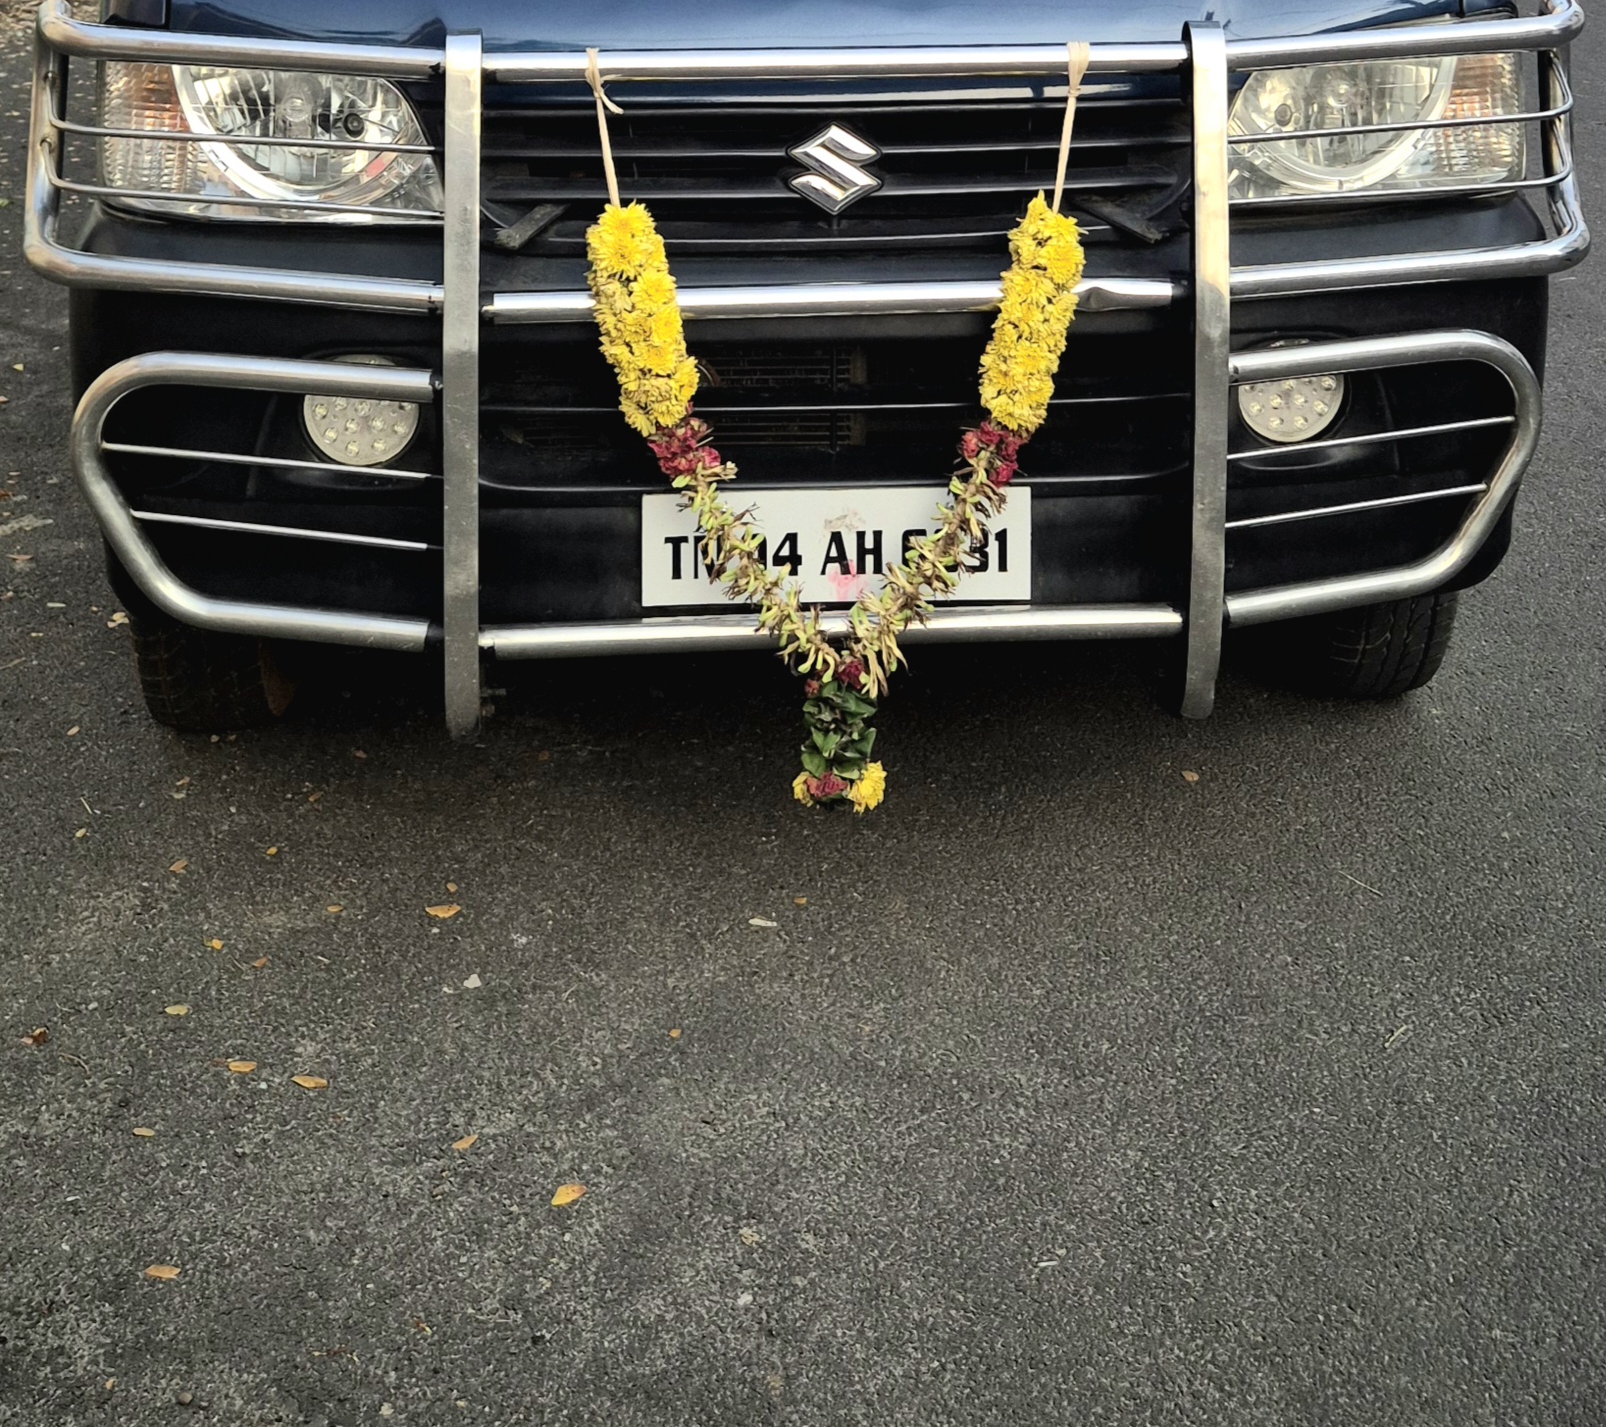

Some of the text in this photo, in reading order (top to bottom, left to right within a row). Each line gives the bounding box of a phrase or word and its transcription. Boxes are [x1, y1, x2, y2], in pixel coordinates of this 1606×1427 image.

[664, 533, 724, 580] TN
[820, 529, 883, 575] AH
[902, 528, 1008, 573] 631
